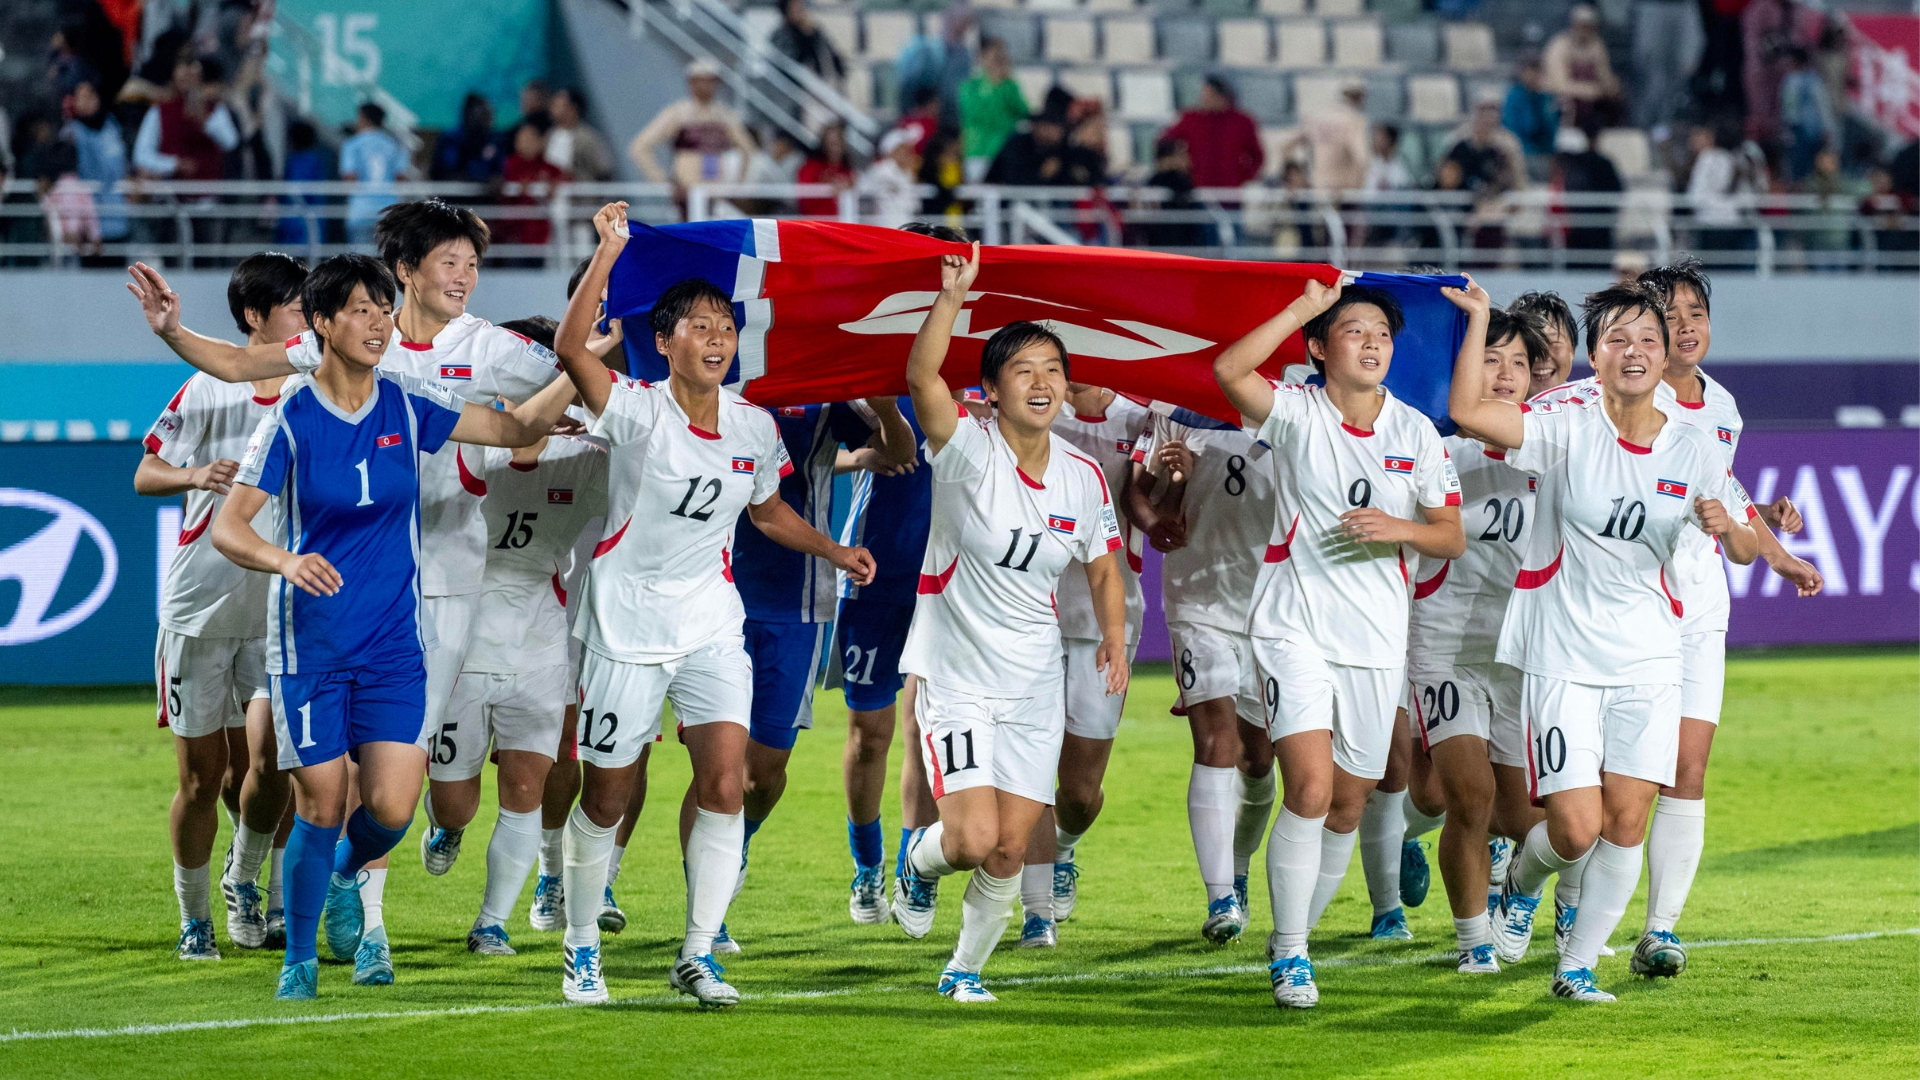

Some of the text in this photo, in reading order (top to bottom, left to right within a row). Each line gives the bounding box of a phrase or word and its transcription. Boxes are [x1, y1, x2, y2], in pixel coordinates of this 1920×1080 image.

[316, 12, 381, 84] 15
[357, 457, 374, 507] 1
[670, 474, 723, 522] 12
[1225, 454, 1246, 496] 8
[1348, 478, 1372, 508] 9
[494, 509, 538, 549] 15
[1478, 497, 1524, 543] 20
[1598, 495, 1646, 541] 10
[1724, 464, 1920, 598] AY
[994, 526, 1042, 573] 11
[843, 645, 878, 686] 21
[1180, 648, 1196, 690] 8
[169, 676, 182, 717] 5
[1265, 676, 1280, 724] 9
[1423, 680, 1460, 731] 20
[298, 701, 318, 750] 1
[430, 721, 458, 766] 15
[579, 707, 619, 755] 12
[940, 727, 977, 774] 11
[1535, 726, 1567, 778] 10
